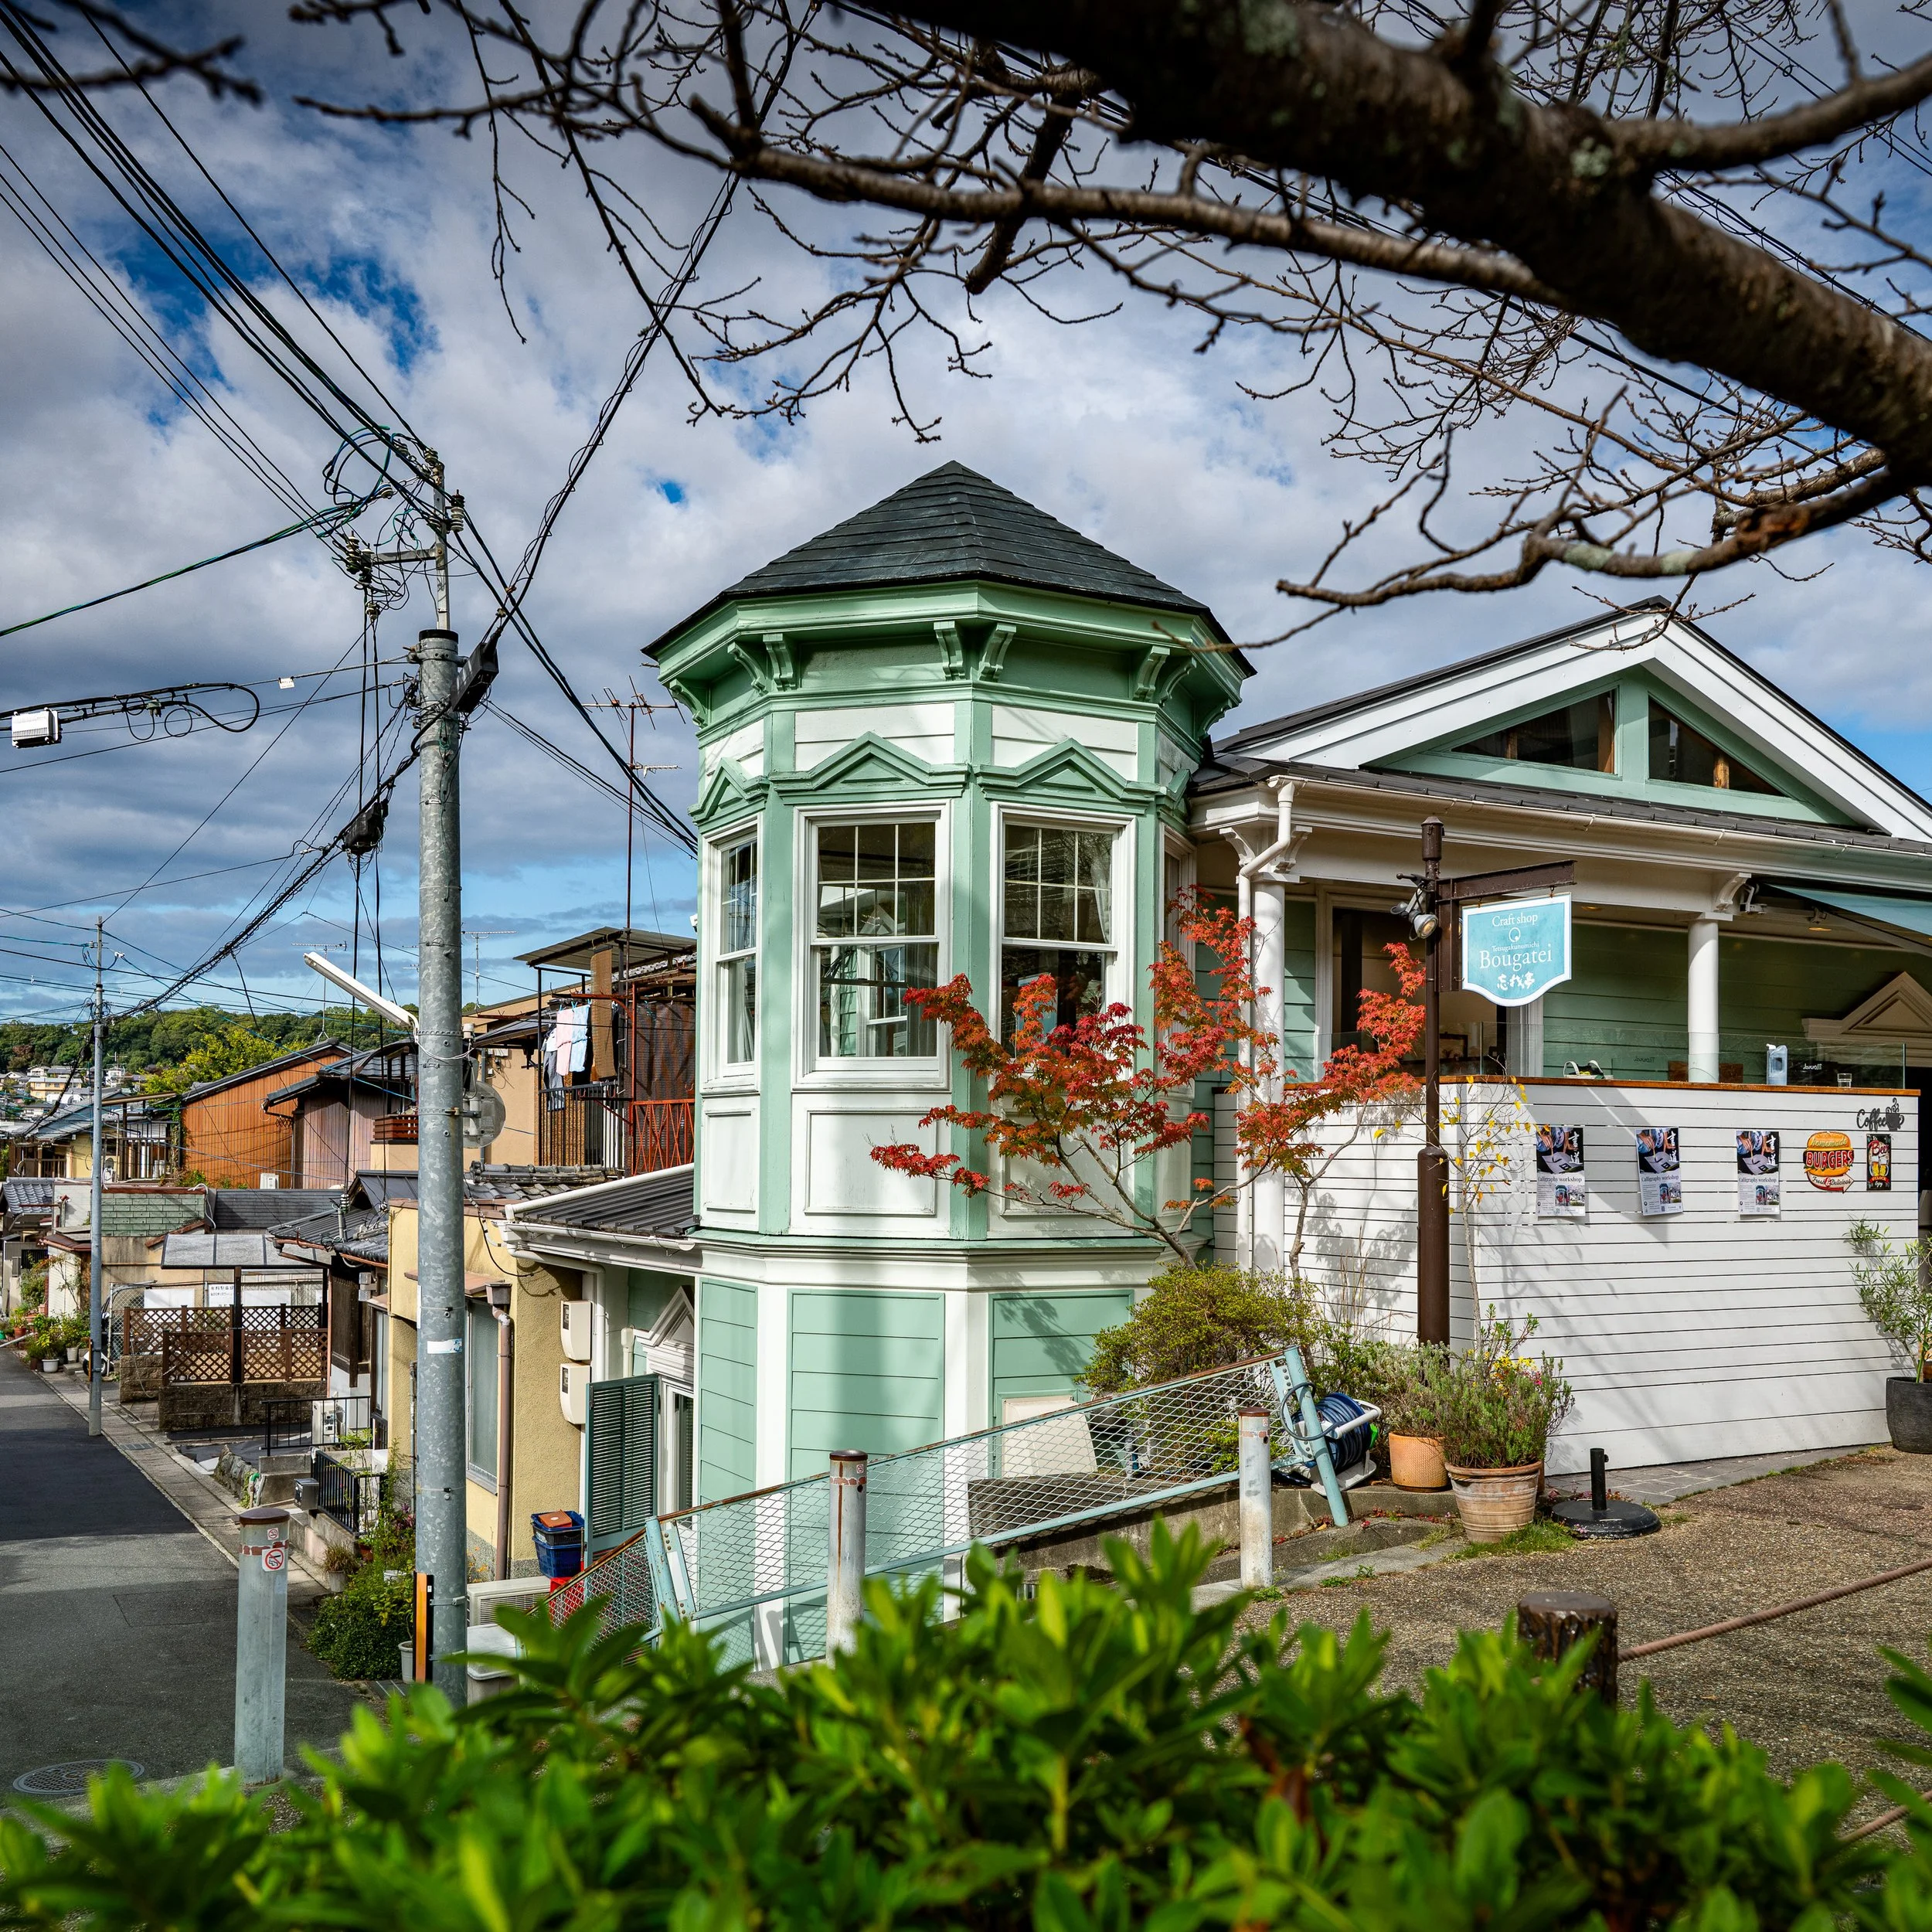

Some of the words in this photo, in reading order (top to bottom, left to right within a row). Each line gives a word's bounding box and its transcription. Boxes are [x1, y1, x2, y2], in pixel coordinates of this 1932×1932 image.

[1492, 913, 1515, 927] Craft
[1516, 912, 1538, 925] shop
[1492, 940, 1539, 952] Tetsugakunomichi
[1479, 944, 1552, 971] Bougatei
[1856, 1108, 1887, 1132] Coffee
[1811, 1136, 1847, 1147] homemade
[1868, 1140, 1889, 1155] Beer
[1806, 1150, 1853, 1169] BURGERS
[1812, 1176, 1825, 1185] Fresh
